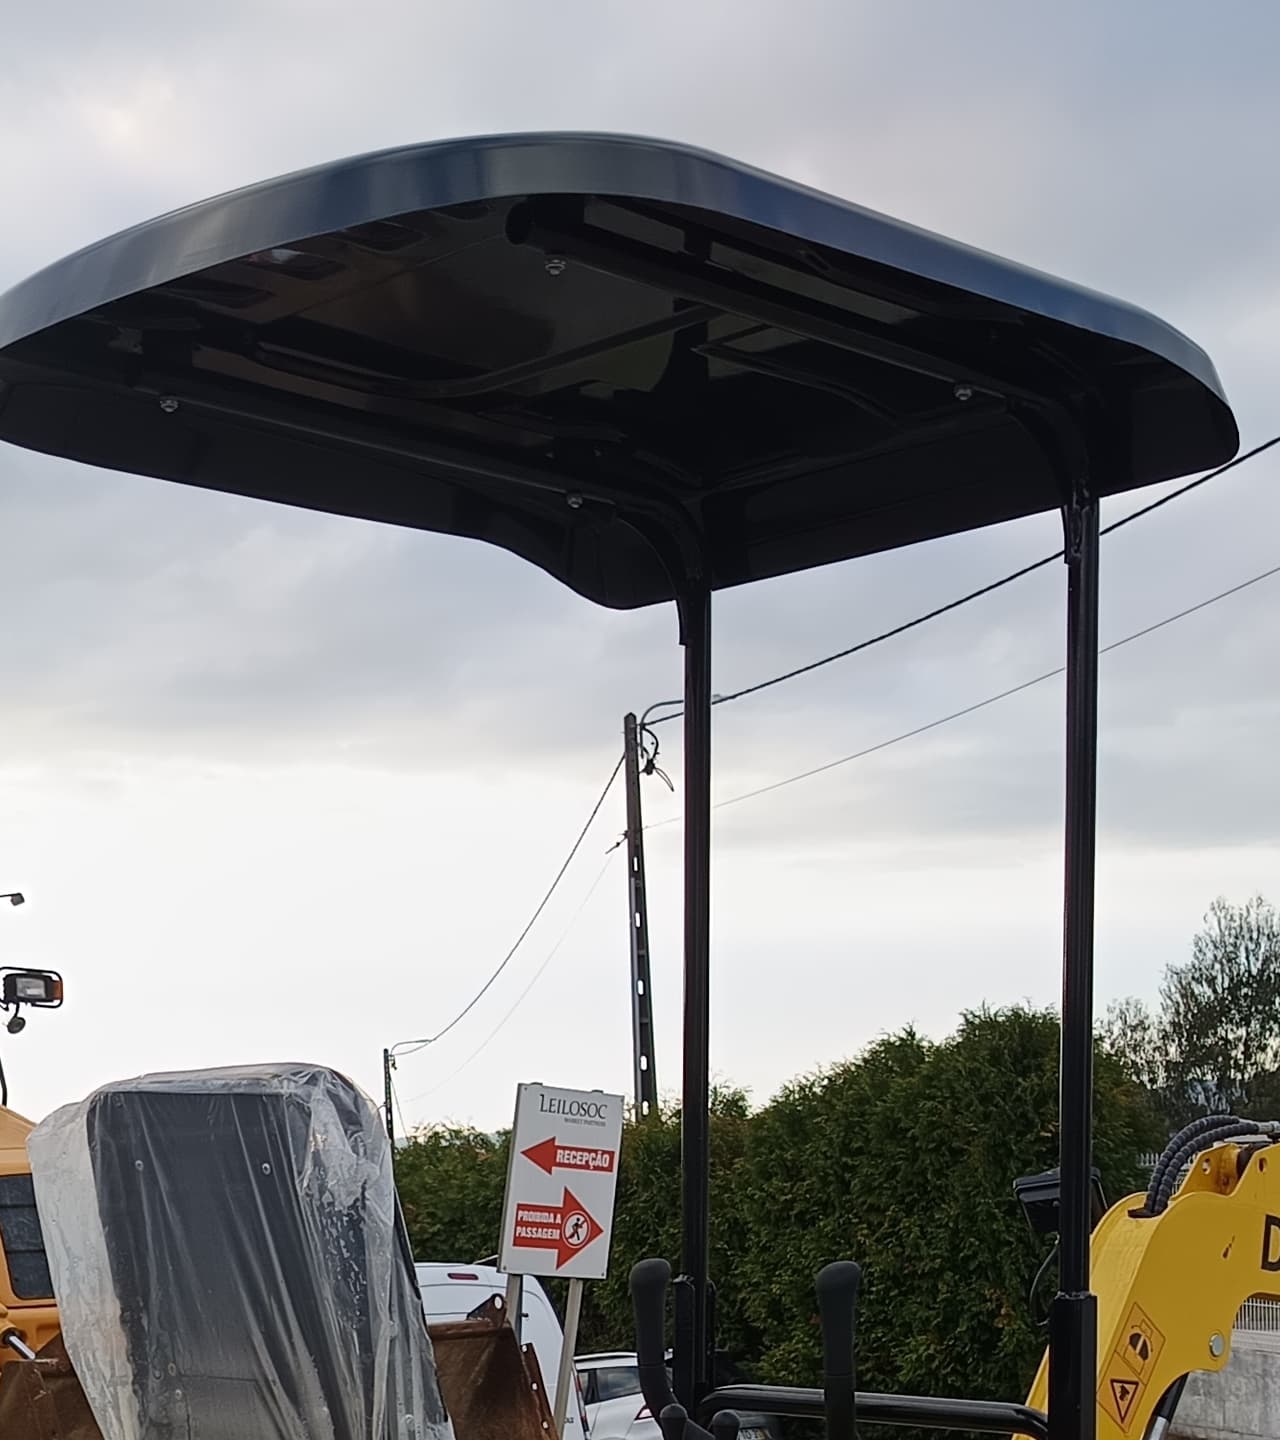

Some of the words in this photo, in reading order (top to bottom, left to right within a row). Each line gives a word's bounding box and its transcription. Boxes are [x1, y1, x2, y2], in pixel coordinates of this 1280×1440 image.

[539, 1093, 608, 1119] LEILOSOC
[556, 1149, 609, 1169] RECEPÇÃO
[555, 1213, 562, 1224] A
[516, 1226, 560, 1240] PASSAGEM
